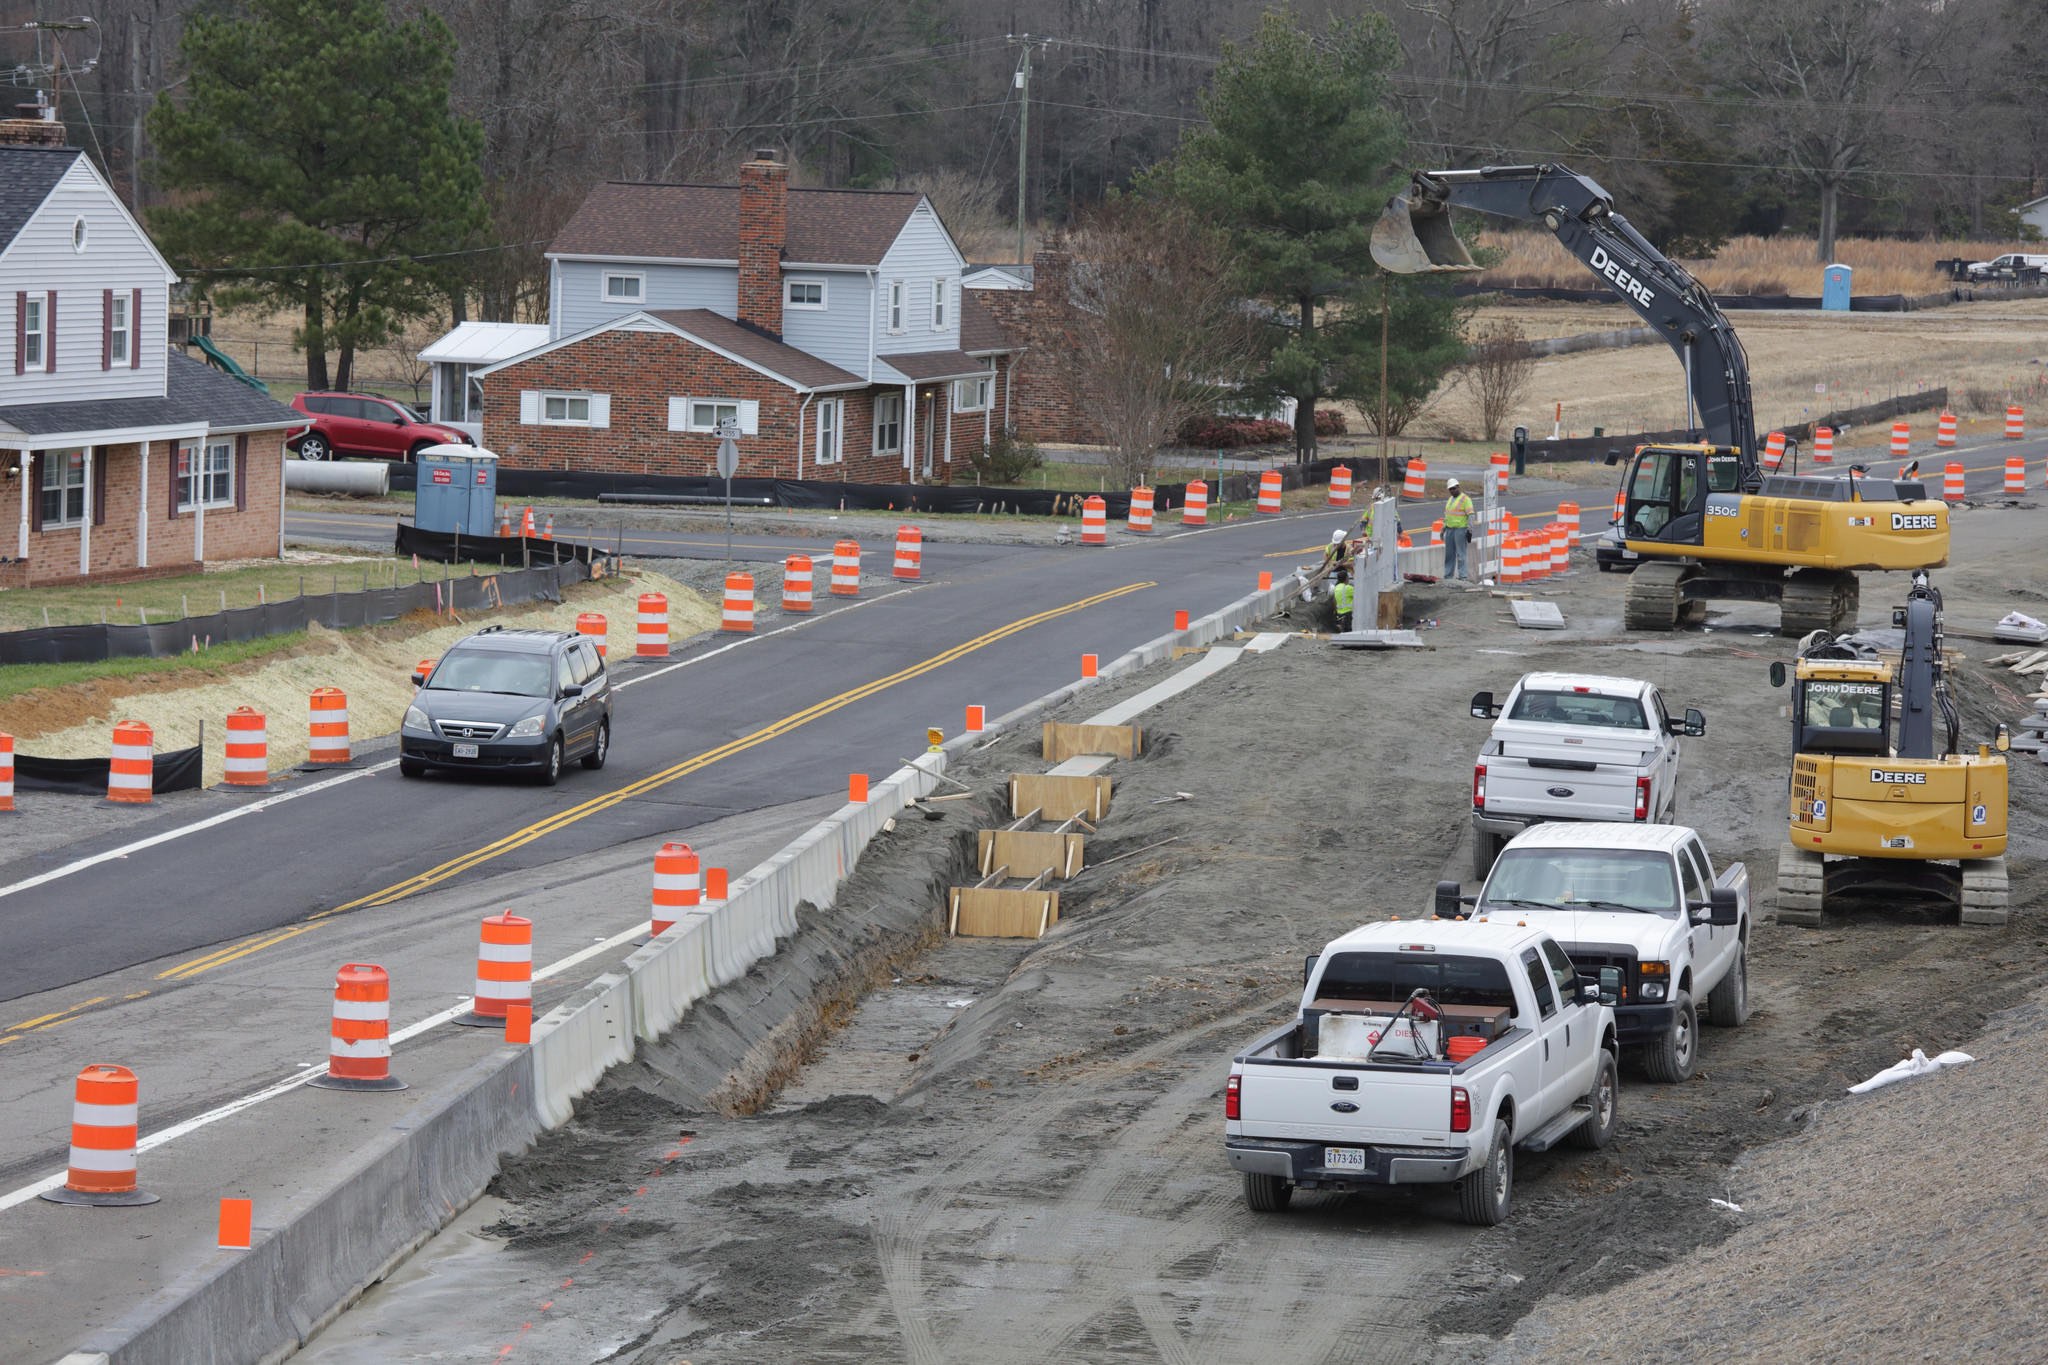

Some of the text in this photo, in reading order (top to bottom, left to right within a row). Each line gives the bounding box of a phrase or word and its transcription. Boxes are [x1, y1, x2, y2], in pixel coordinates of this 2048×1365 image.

[1589, 245, 1656, 309] DEERE
[1707, 505, 1737, 517] 350G
[1891, 513, 1937, 530] DEERE
[1808, 683, 1880, 695] JOHN DEERE
[1871, 769, 1926, 784] DEERE
